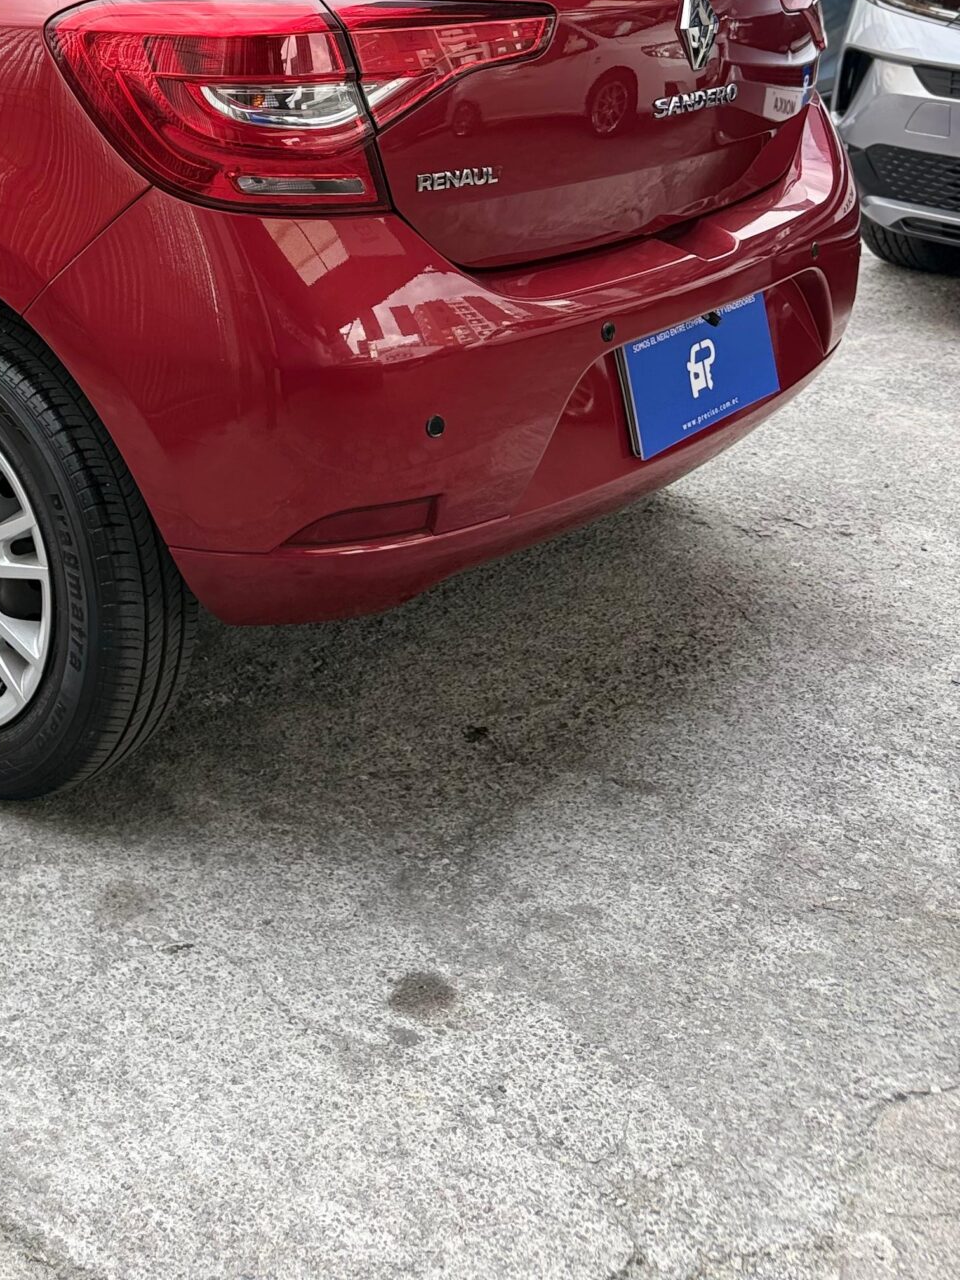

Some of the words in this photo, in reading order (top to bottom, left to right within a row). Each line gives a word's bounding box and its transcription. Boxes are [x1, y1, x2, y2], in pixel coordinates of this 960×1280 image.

[653, 82, 739, 120] SANDERO
[633, 339, 650, 353] SOMOS
[682, 396, 739, 431] www.preciso.com.ec
